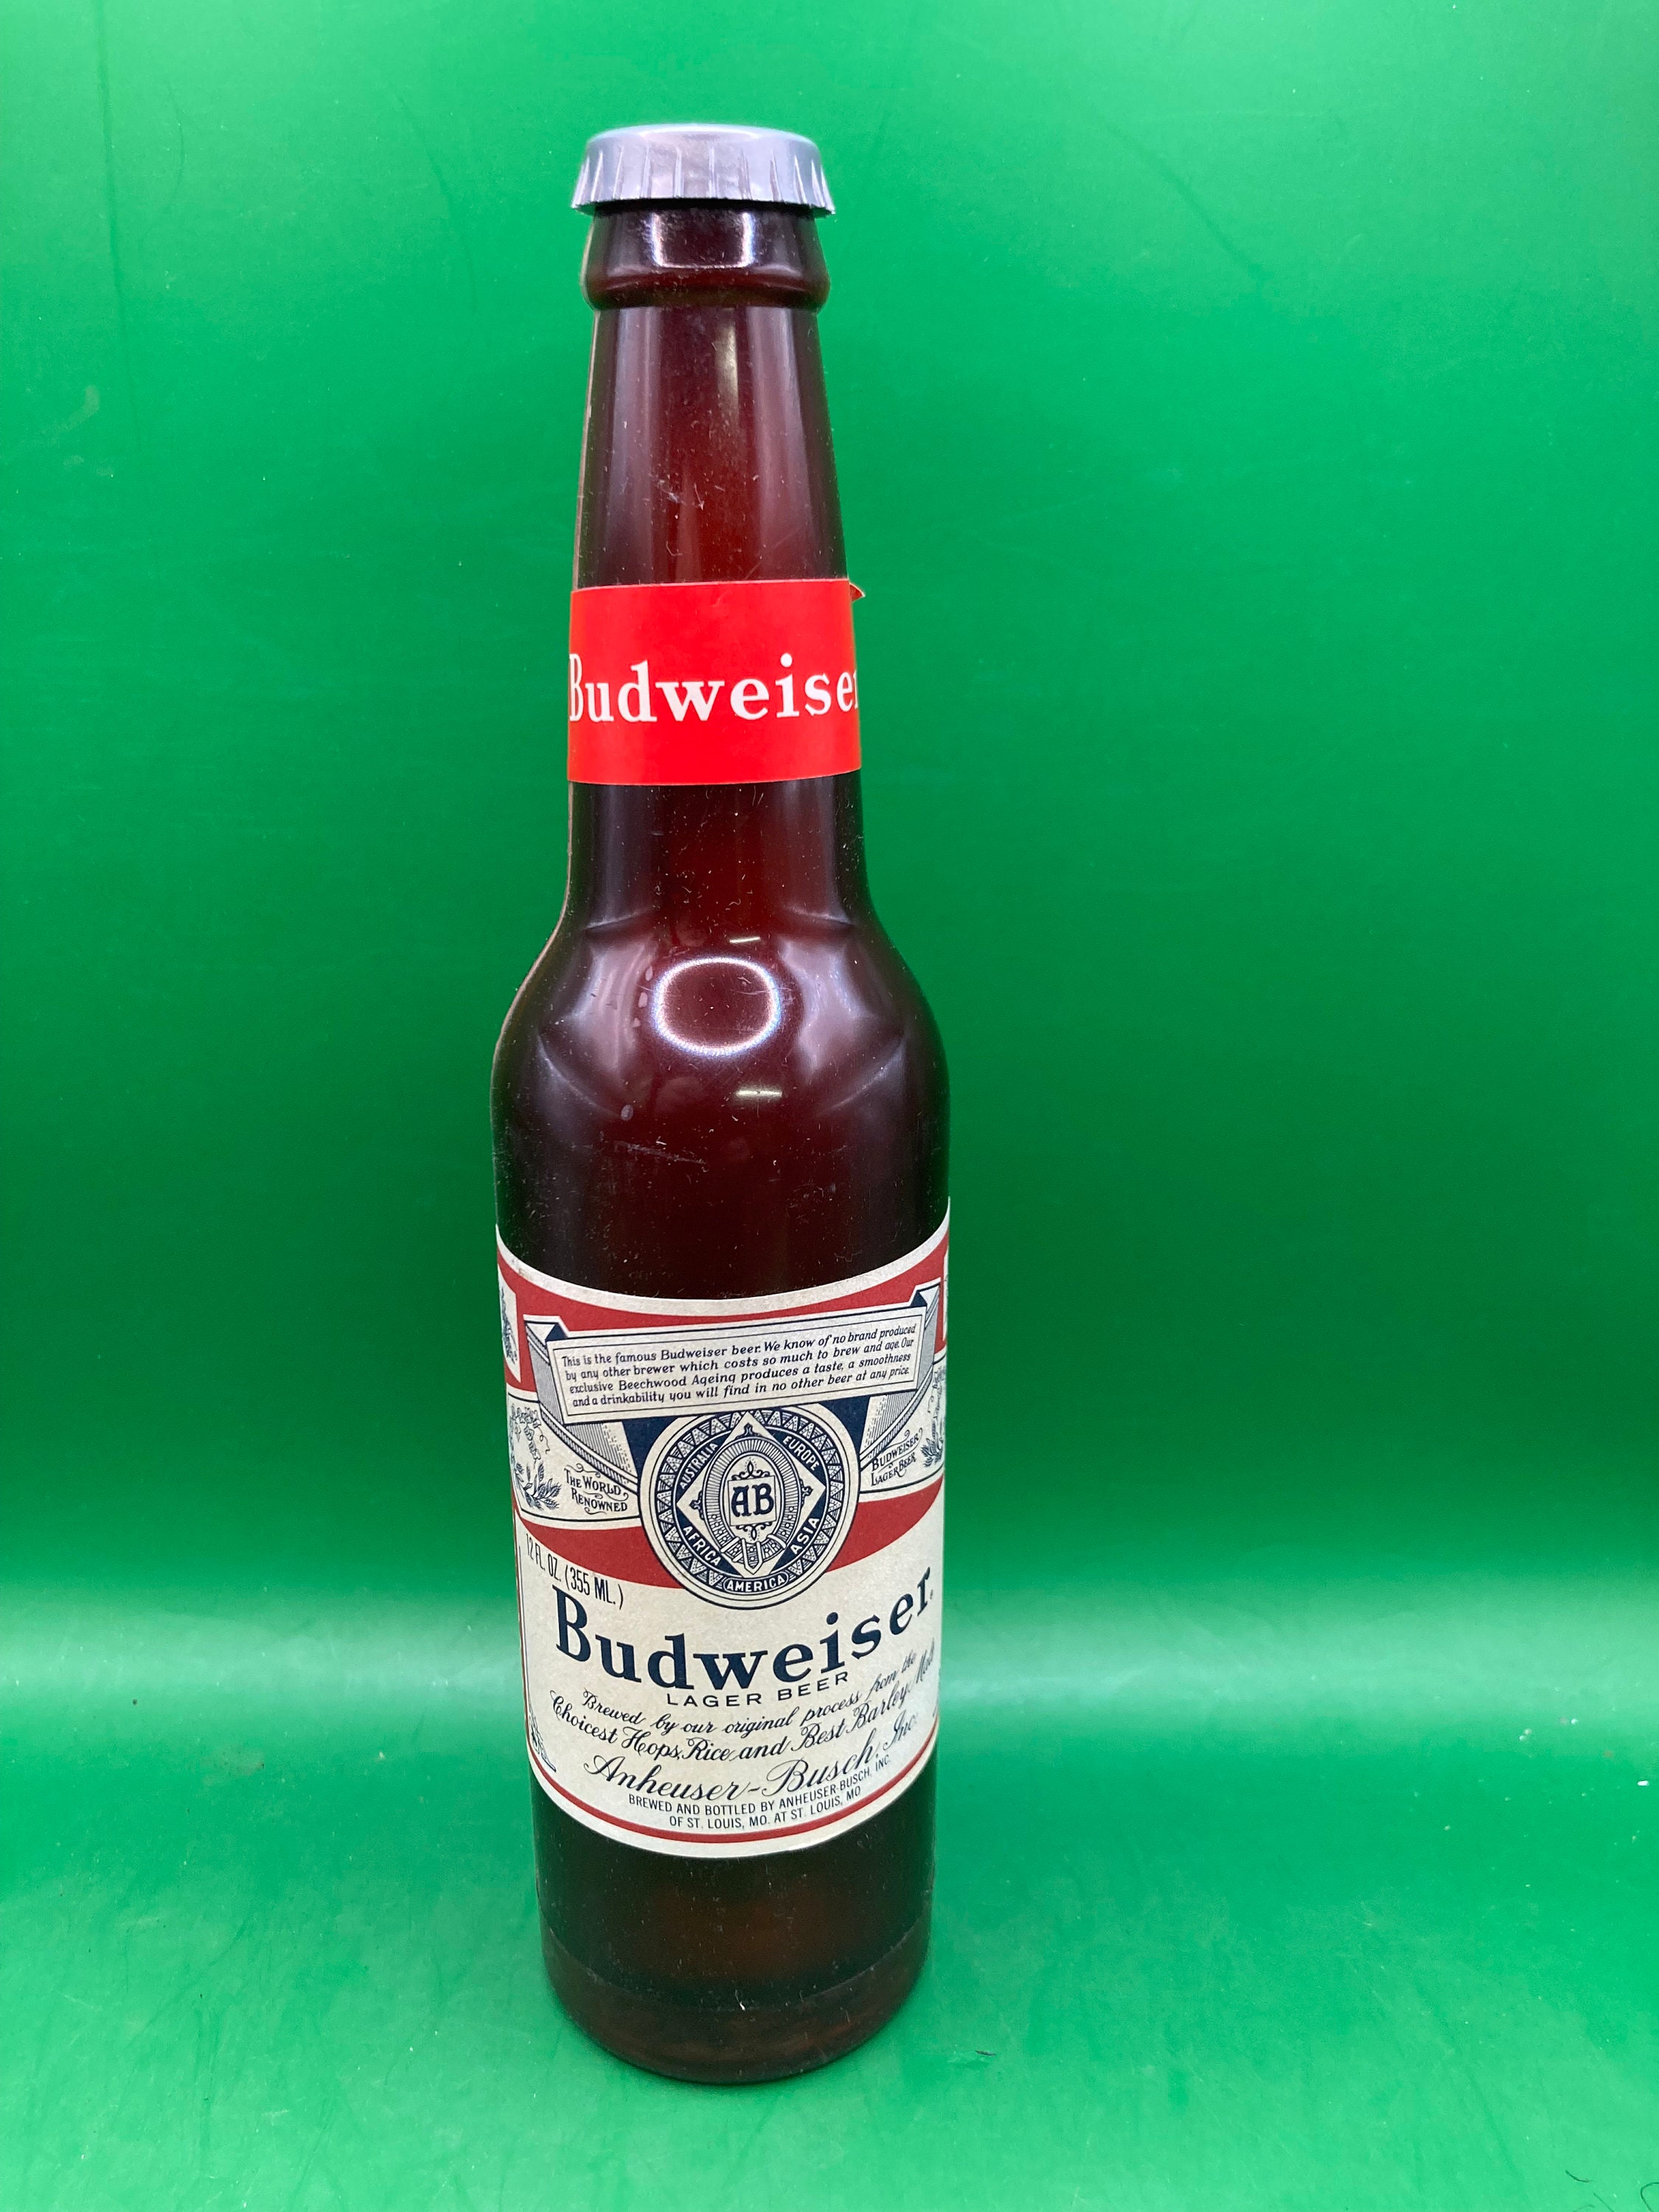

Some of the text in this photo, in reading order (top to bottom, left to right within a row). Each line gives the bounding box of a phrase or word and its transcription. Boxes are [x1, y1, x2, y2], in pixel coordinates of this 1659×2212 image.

[562, 1323, 917, 1367] This is the famous Budweiser beer. We know of no brand produced
[566, 1337, 914, 1382] by any other brewer which costs so much to brew and age. Our
[569, 1352, 911, 1394] exclusive Beechwood Ageing produces a taste, a smoothness
[573, 1366, 910, 1408] and a drinkability you will find in no other beer at any price.
[679, 1443, 719, 1489] AUSTRALIA
[782, 1435, 820, 1472] EUROPE
[871, 1433, 919, 1472] BUDWEISER
[871, 1452, 917, 1487] LAGER BEER
[563, 1467, 623, 1497] THE WORLD
[571, 1486, 628, 1512] RENOWNED
[731, 1482, 774, 1517] AB
[682, 1526, 722, 1566] AFRICA
[790, 1517, 821, 1555] ASIA
[526, 1533, 534, 1560] 12
[548, 1553, 562, 1582] OZ.
[565, 1564, 591, 1596] (355
[726, 1575, 786, 1593] AMERICA
[552, 1566, 931, 1691] Budweiser
[582, 1649, 917, 1739] Brewed by our original process from the
[667, 1671, 849, 1708] LAGER BEER
[549, 1689, 619, 1744] Choicest
[621, 1726, 682, 1761] Hops,
[682, 1736, 736, 1761] Rice
[736, 1735, 792, 1760] and
[791, 1718, 847, 1752] Best
[846, 1680, 911, 1733] Barley
[628, 1793, 672, 1813] BREWED
[676, 1803, 700, 1815] AND
[705, 1803, 757, 1816] BOTTLED
[760, 1800, 775, 1812] BY
[669, 1815, 684, 1827] OF
[708, 1816, 745, 1830] LOUIS,
[749, 1815, 771, 1827] MO.
[774, 1810, 787, 1823] AT
[810, 1795, 844, 1815] LOUIS,
[846, 1785, 861, 1801] MO
